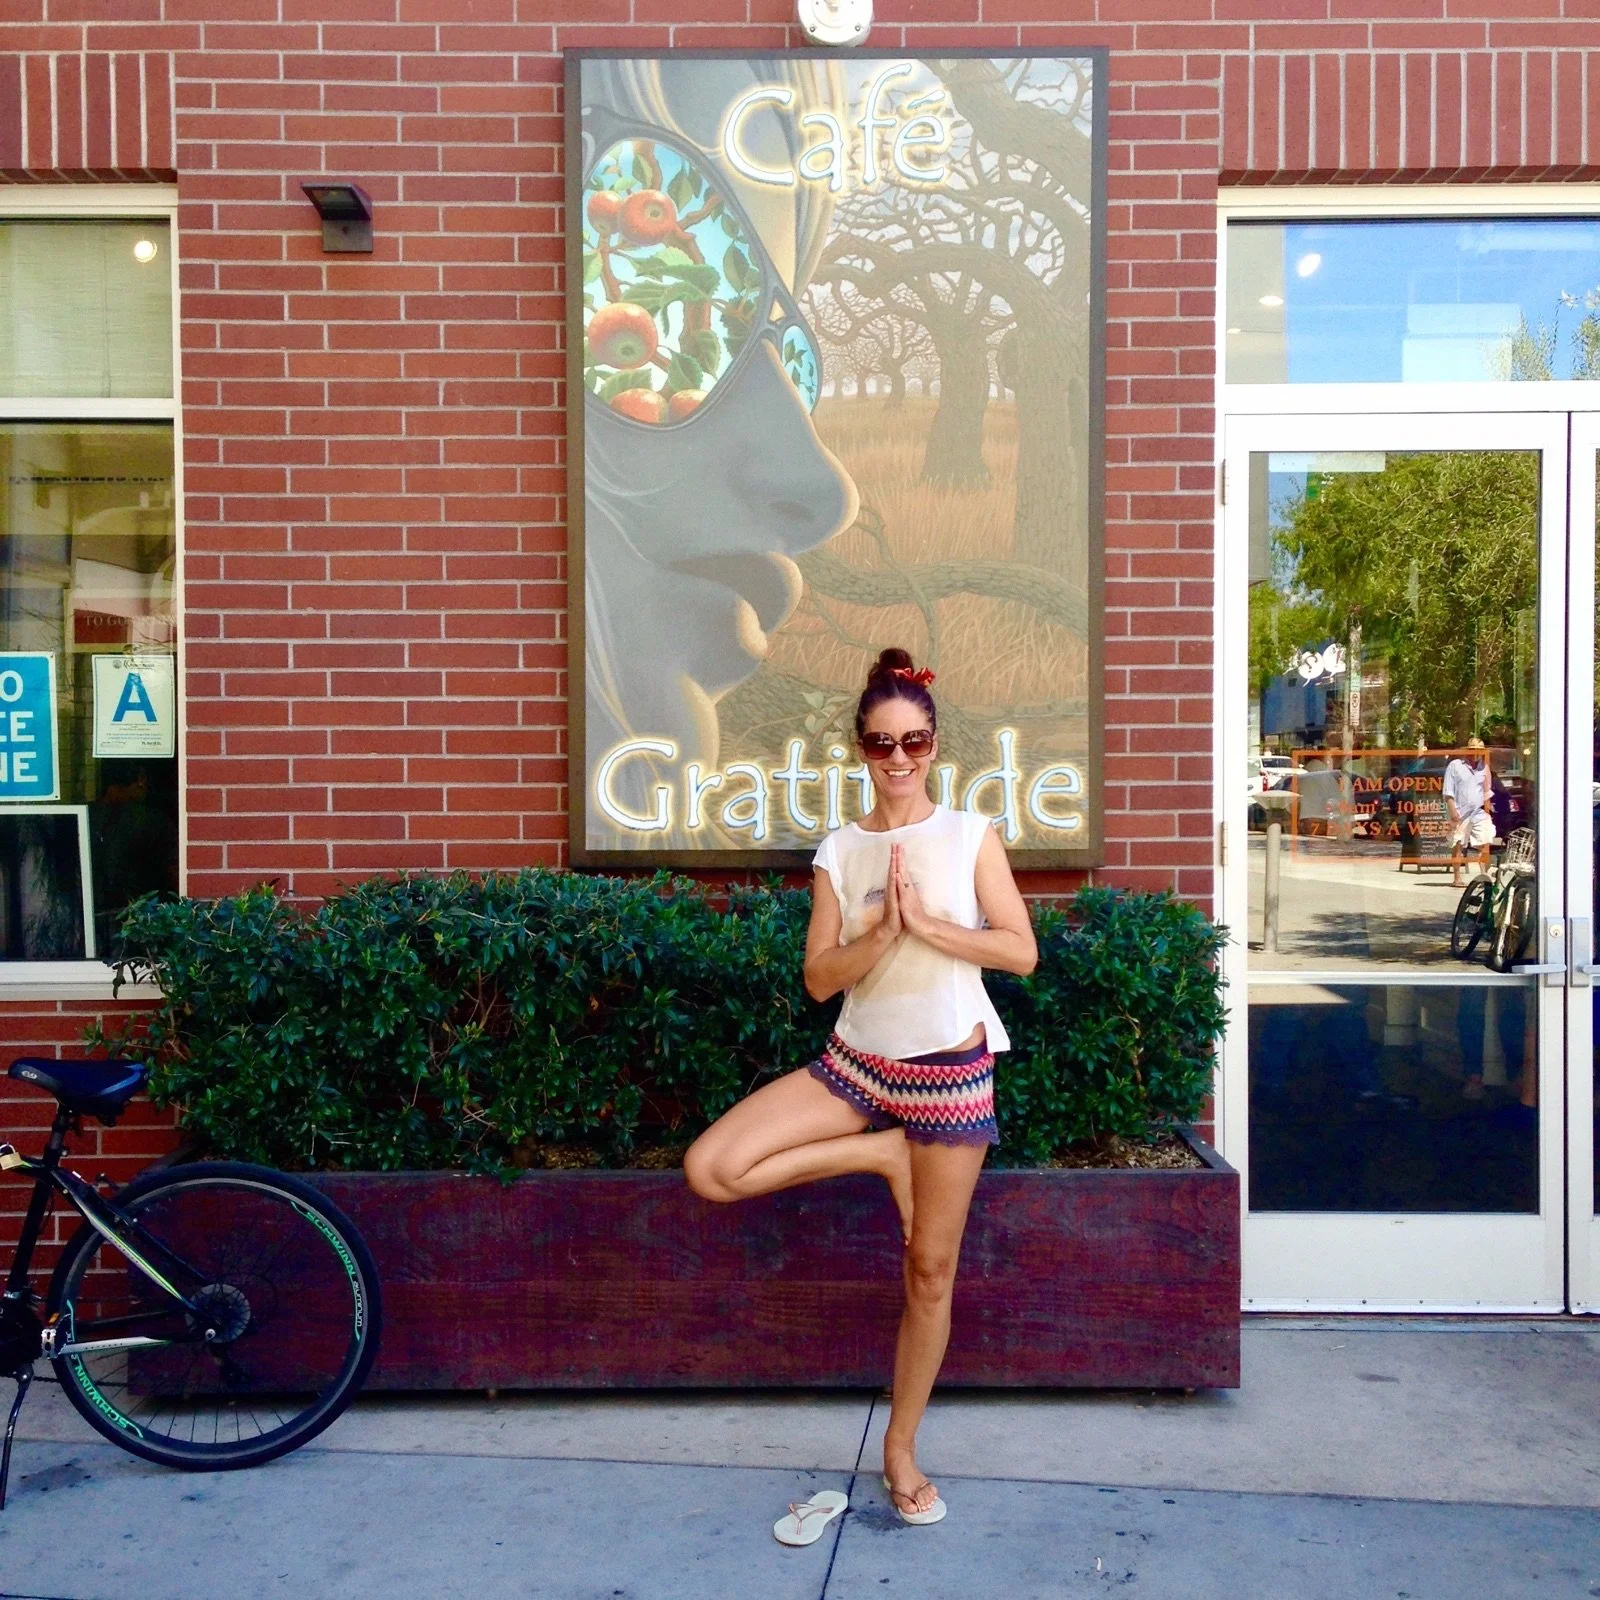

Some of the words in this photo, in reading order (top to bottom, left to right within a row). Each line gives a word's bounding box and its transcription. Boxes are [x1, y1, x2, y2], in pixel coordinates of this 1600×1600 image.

[724, 63, 945, 192] Café
[84, 615, 103, 627] TO
[112, 672, 158, 722] A
[0, 710, 35, 742] E
[0, 751, 39, 782] E
[596, 730, 1082, 842] Gratide
[1353, 776, 1383, 792] AM
[1388, 776, 1444, 792] OPEN
[1310, 822, 1320, 837] 7
[1387, 821, 1401, 836] A
[1407, 821, 1463, 837] WEE
[305, 1211, 357, 1276] SCHWINN
[74, 1364, 128, 1429] SCHWINN
